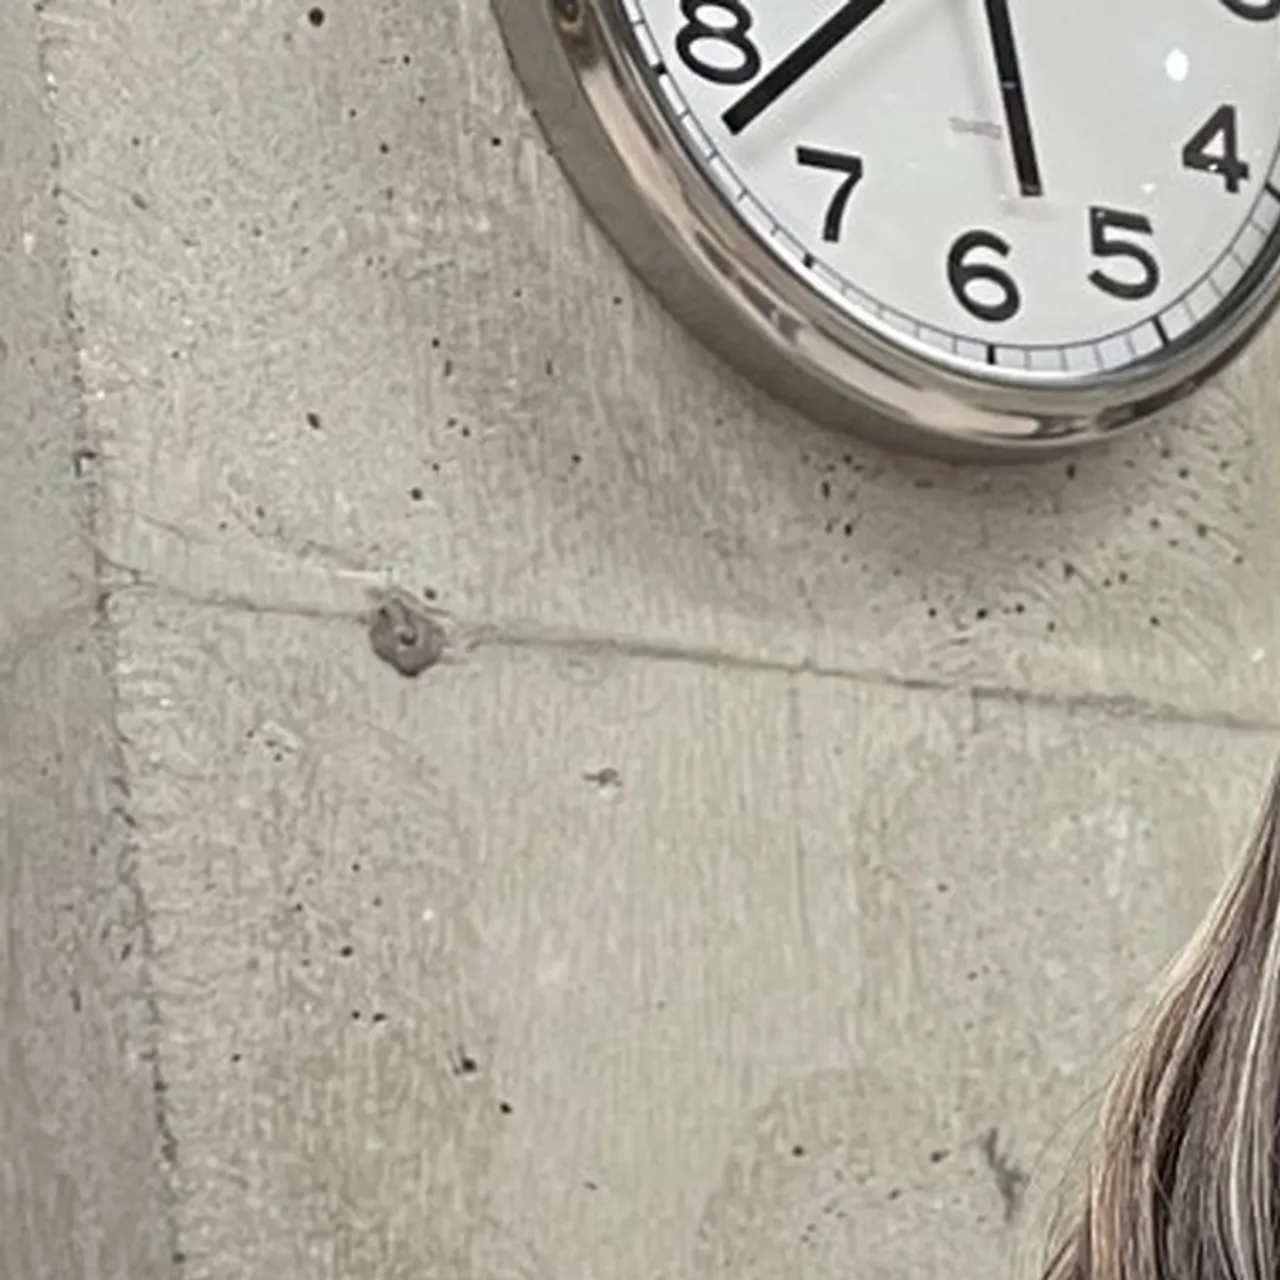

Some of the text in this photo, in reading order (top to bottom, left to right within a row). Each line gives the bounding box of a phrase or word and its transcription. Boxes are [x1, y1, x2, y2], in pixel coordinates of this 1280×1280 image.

[675, 0, 761, 85] 8
[796, 146, 863, 242] 7
[1182, 105, 1249, 193] 4
[947, 230, 1020, 322] 6
[1088, 206, 1159, 299] 5
